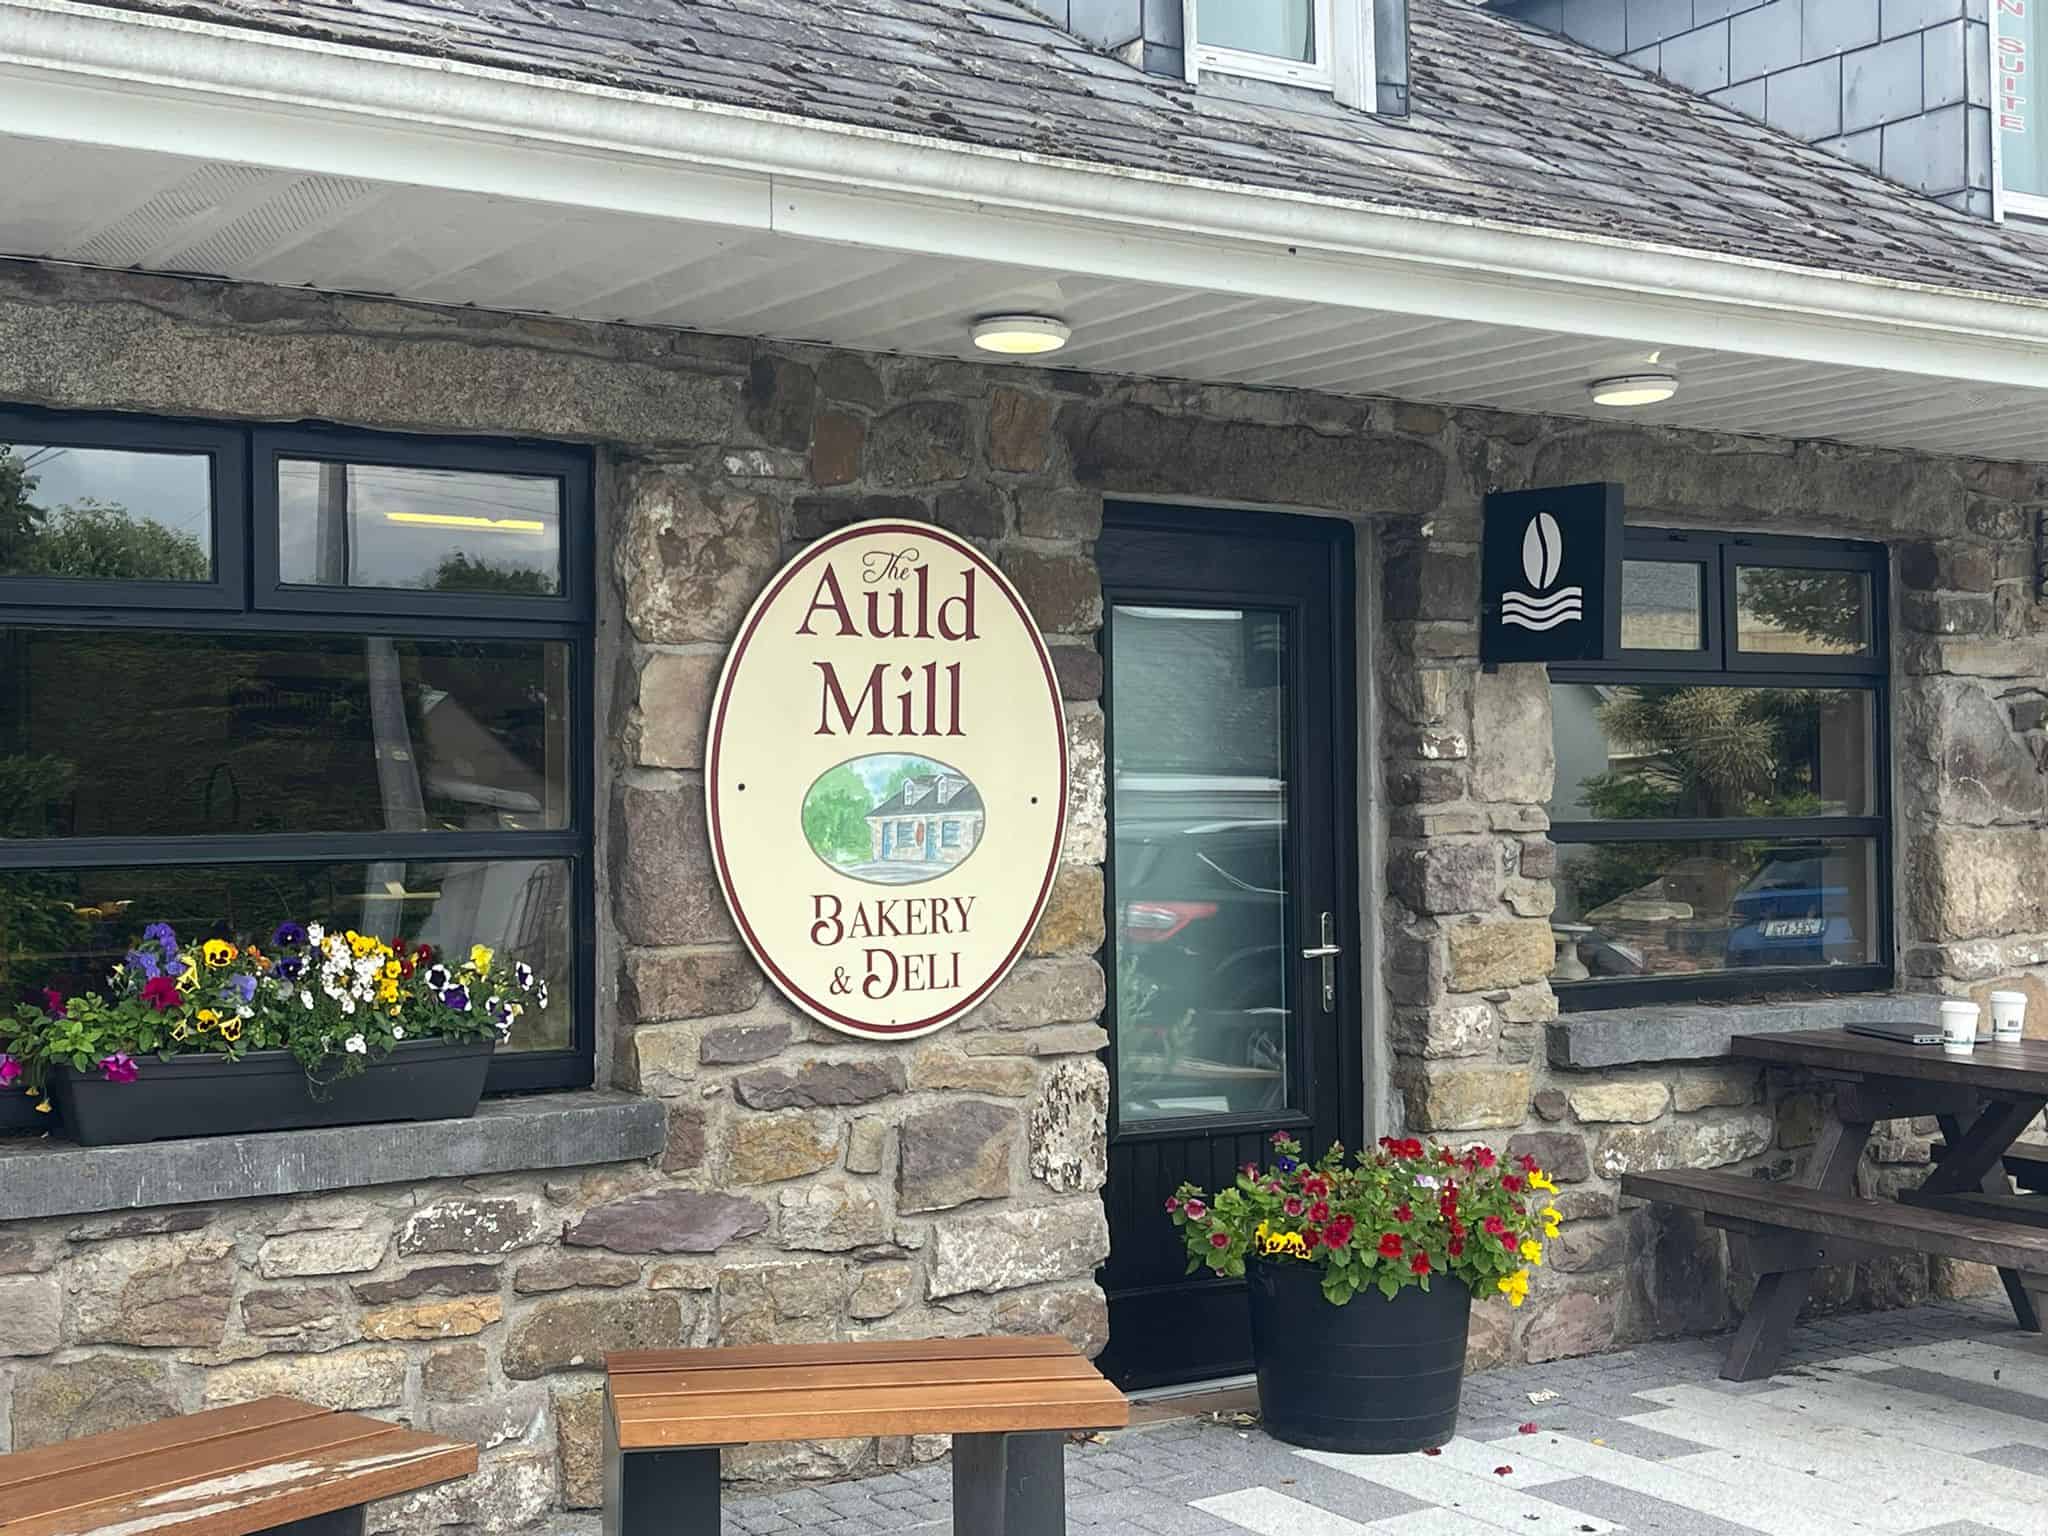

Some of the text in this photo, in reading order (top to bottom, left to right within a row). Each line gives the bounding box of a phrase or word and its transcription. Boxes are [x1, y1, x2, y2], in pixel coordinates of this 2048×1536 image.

[862, 547, 920, 584] The
[795, 562, 981, 642] Auld
[812, 660, 967, 737] Mill
[810, 894, 977, 947] BAKERY
[829, 948, 961, 1000] & DELI
